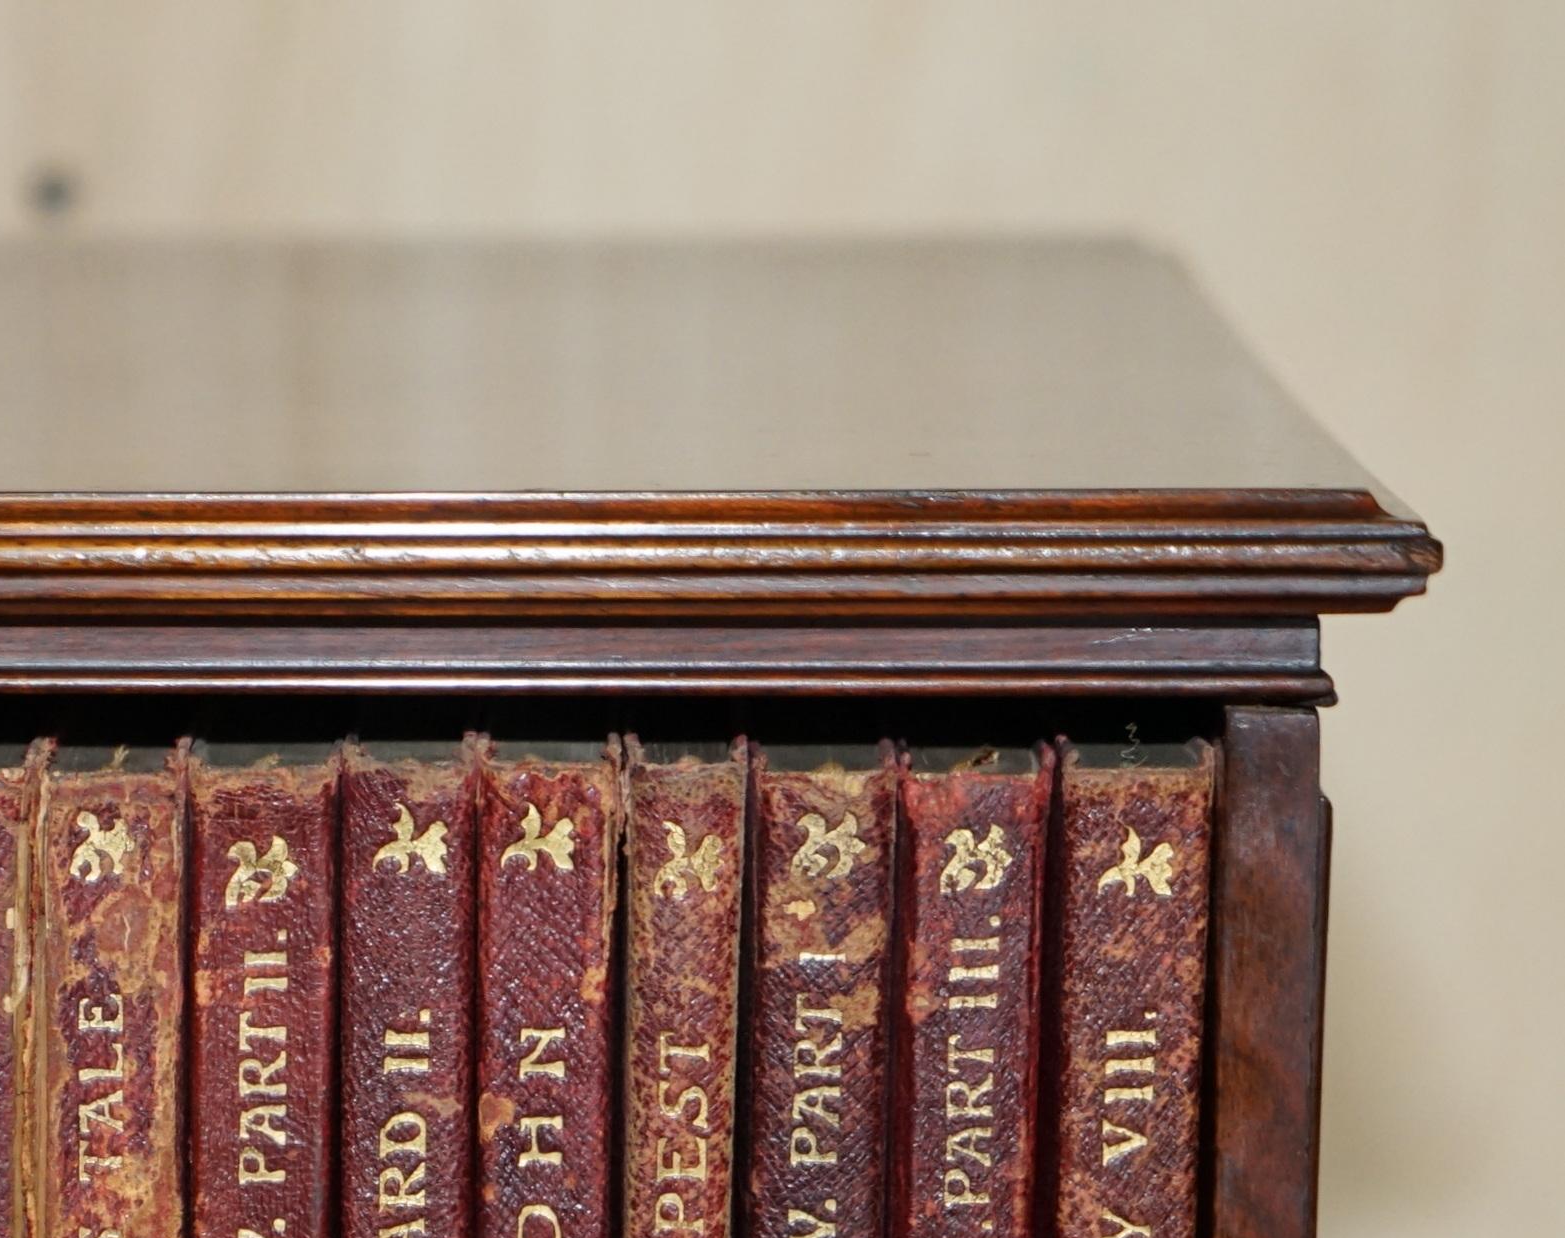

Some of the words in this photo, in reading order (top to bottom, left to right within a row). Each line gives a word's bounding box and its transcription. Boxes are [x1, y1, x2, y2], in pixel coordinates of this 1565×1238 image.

[243, 927, 289, 995] II.
[947, 913, 1002, 1011] III.
[77, 992, 125, 1182] TALE
[238, 1010, 287, 1185] PART
[382, 1008, 431, 1074] II.
[788, 992, 844, 1167] PART
[1101, 1010, 1158, 1167] VIII.
